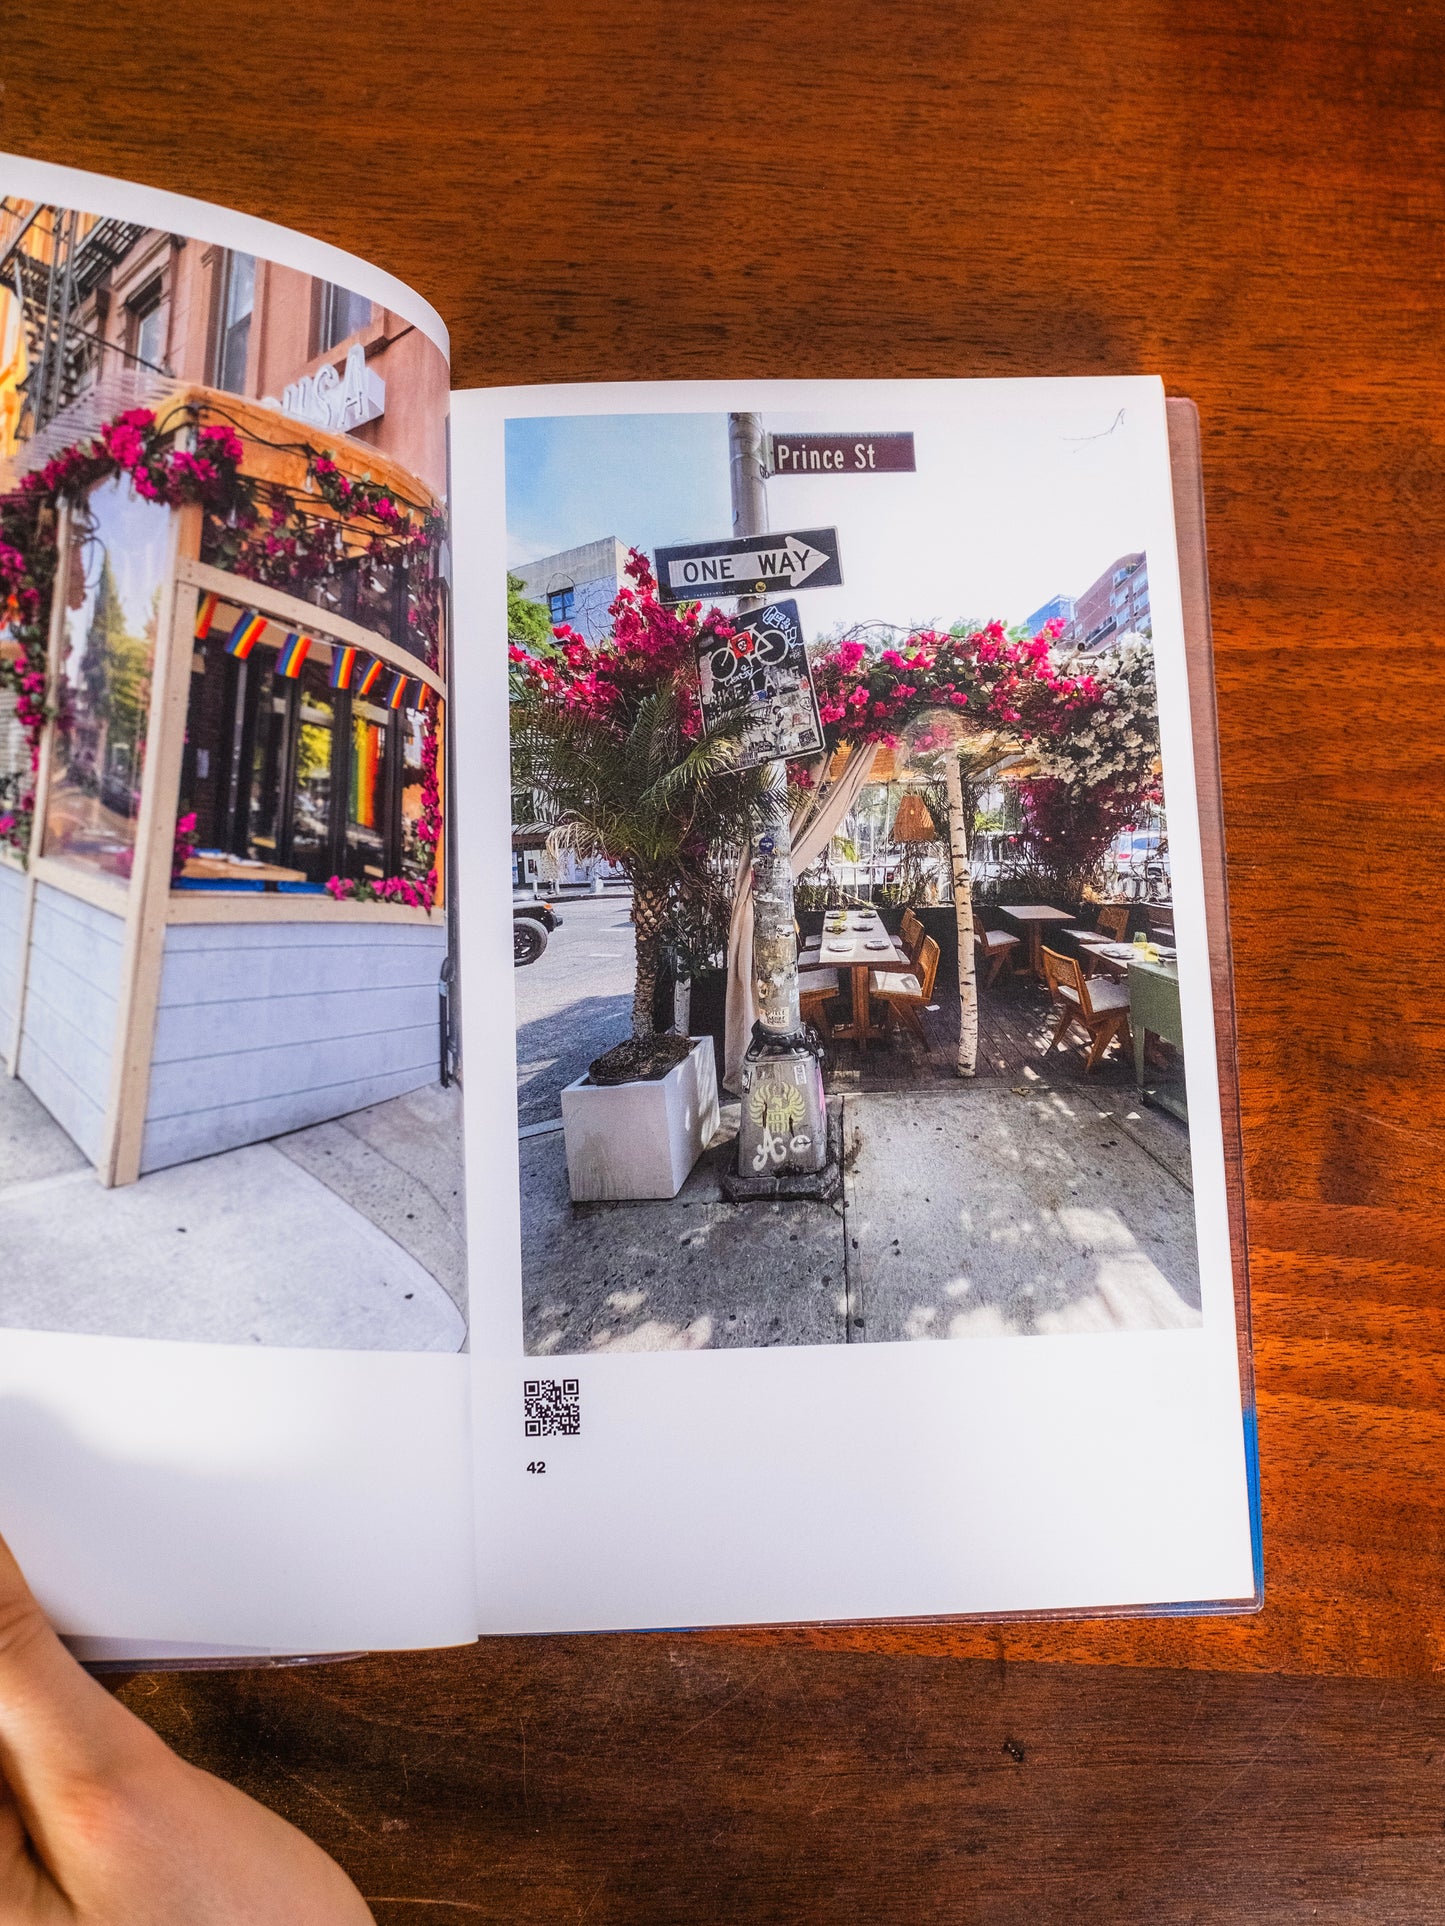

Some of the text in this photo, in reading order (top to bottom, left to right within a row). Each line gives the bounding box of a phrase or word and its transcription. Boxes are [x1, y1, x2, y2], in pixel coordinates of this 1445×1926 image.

[778, 443, 876, 469] Prince St
[683, 550, 811, 583] ONE WAY
[526, 1461, 546, 1474] 42
